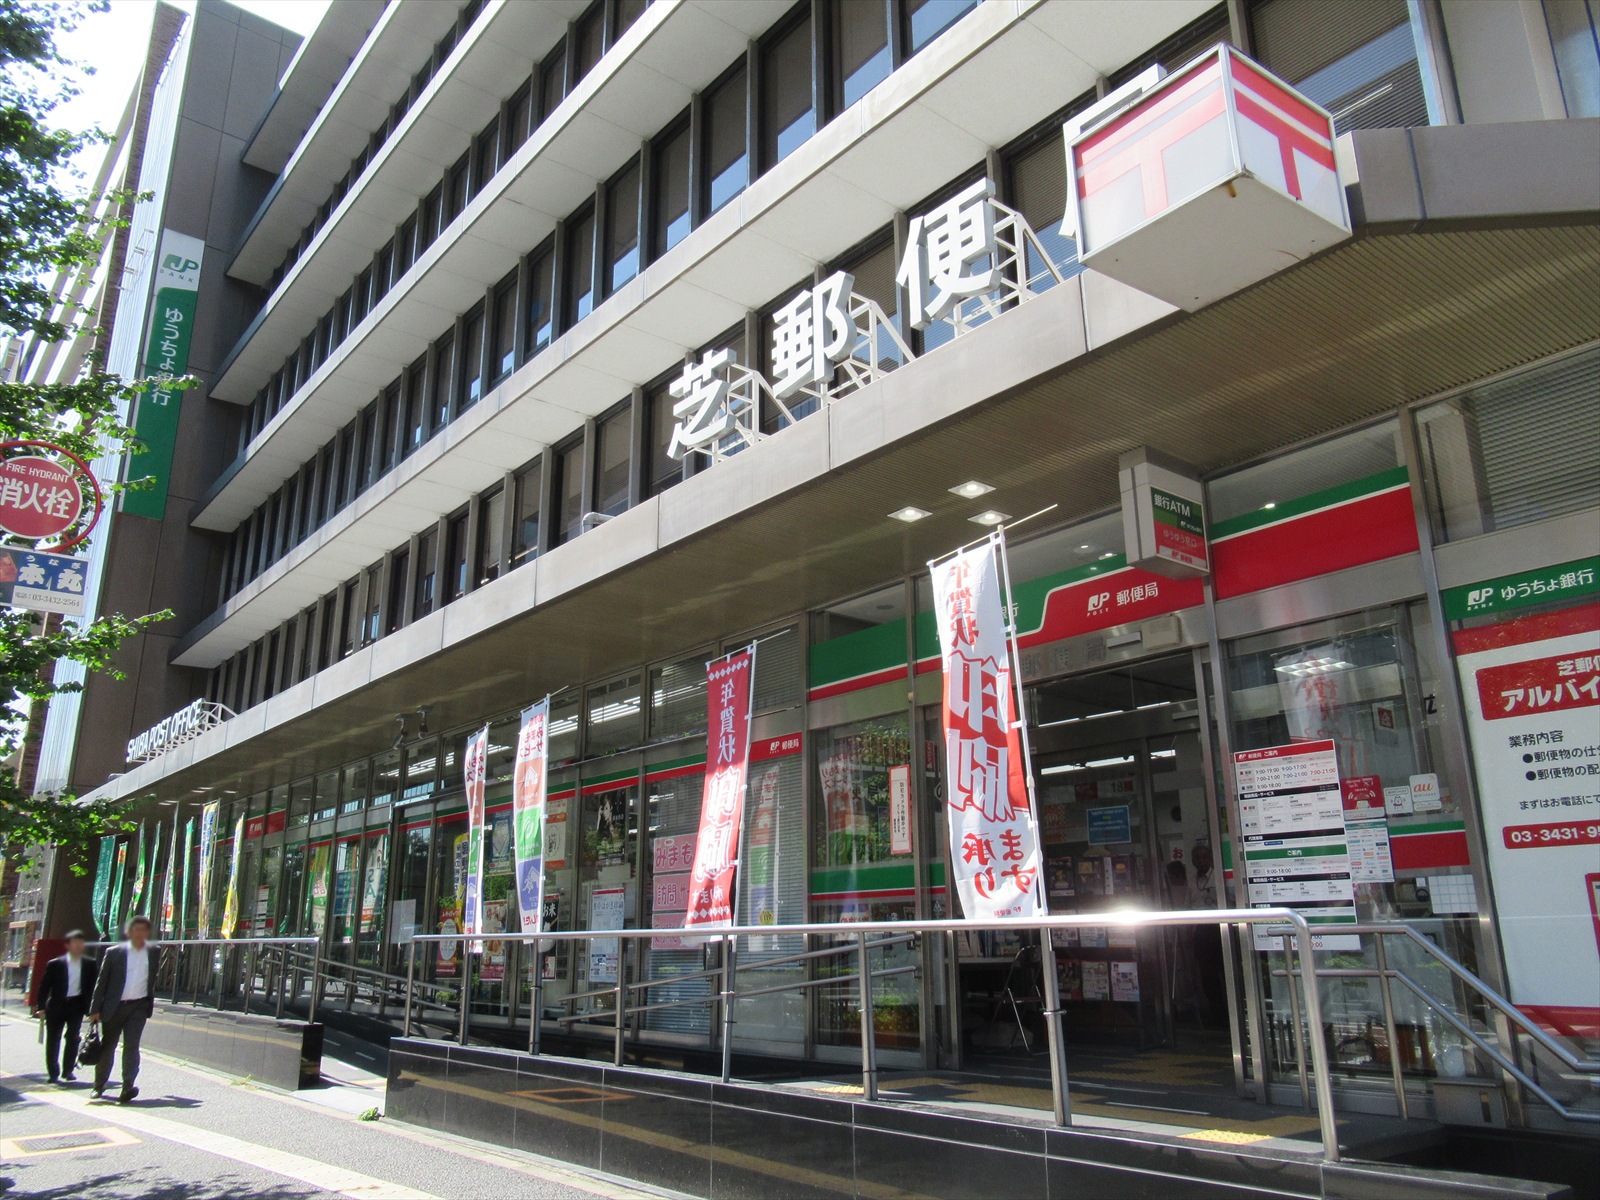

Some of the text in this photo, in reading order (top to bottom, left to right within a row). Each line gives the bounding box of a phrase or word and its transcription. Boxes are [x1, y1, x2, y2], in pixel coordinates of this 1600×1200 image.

[159, 268, 195, 283] BANK
[6, 462, 70, 483] FIRE HYDRANT
[0, 476, 74, 519] 消火栓
[1153, 493, 1191, 517] 銀行ATM
[1163, 529, 1197, 548] ゆうゆう窓口
[1467, 568, 1594, 606] JP ゆうちょ銀行
[1087, 582, 1159, 611] JP 郵便局
[1087, 608, 1110, 617] POST
[1467, 602, 1494, 611] BANK
[1508, 730, 1564, 748] 業務内容
[1255, 767, 1280, 775] 9:00-19:00
[1256, 774, 1280, 782] 7:00-21:00
[1413, 783, 1435, 792] au
